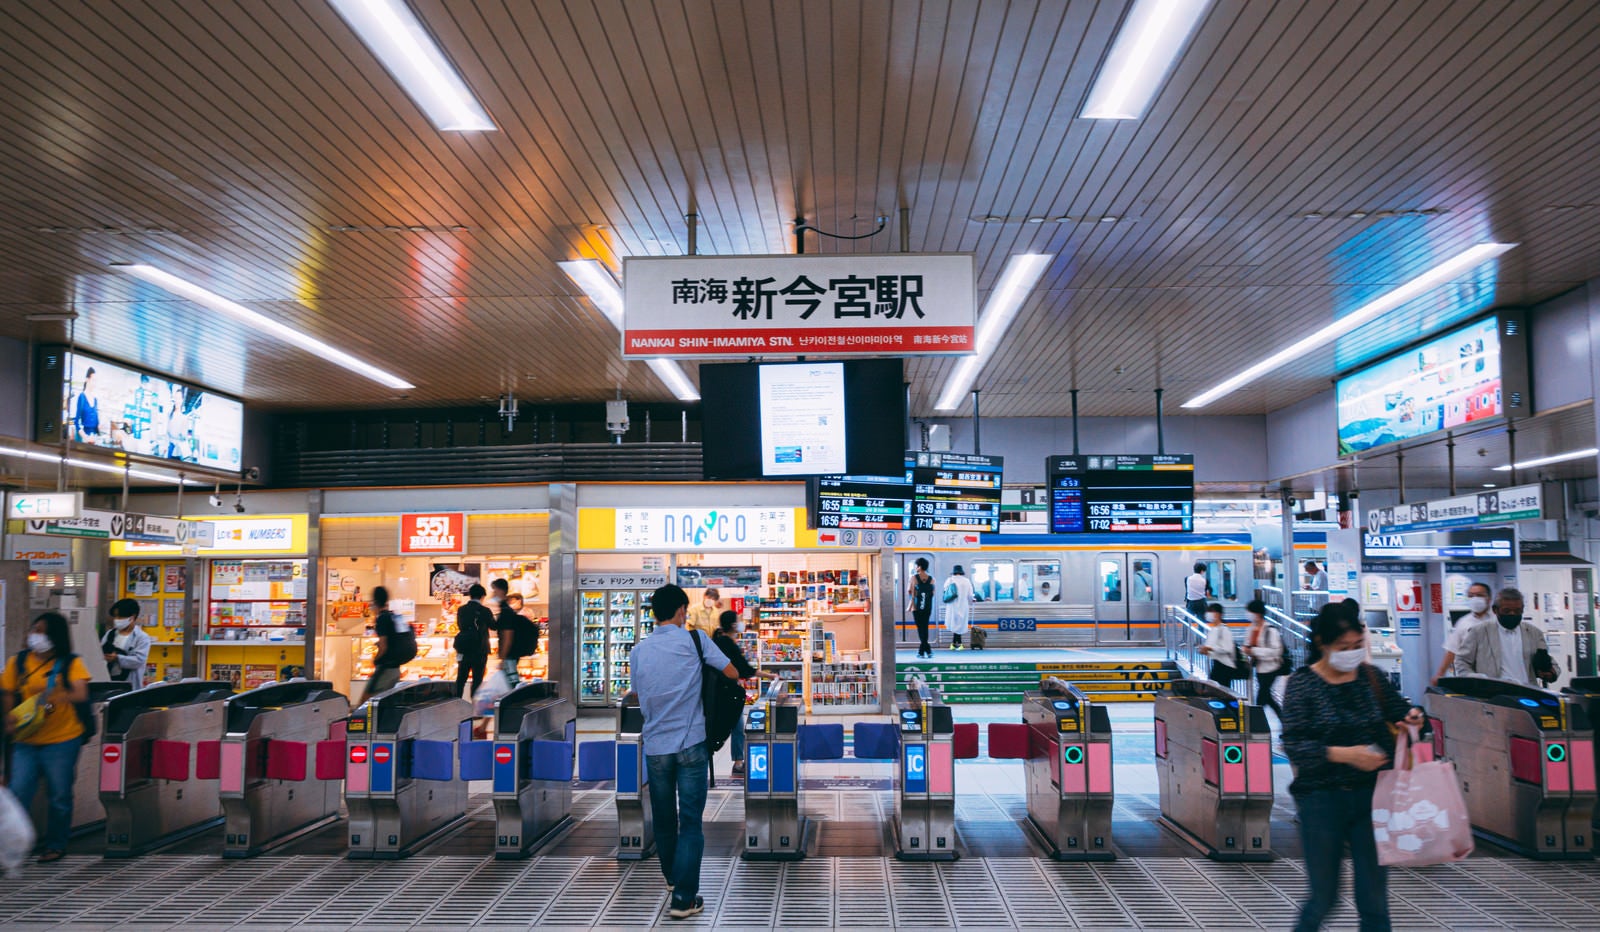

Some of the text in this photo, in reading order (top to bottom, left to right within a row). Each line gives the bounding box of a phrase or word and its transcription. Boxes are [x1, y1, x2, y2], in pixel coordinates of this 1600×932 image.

[631, 336, 794, 348] NANKAI SHIN-IMAMIYA STN.
[906, 473, 913, 482] 2
[994, 476, 1000, 485] 3
[1024, 492, 1030, 502] 1
[822, 500, 840, 511] 16:55
[904, 503, 911, 513] 2
[1489, 495, 1497, 511] 2
[917, 504, 933, 514] 16:59
[992, 506, 998, 515] 3
[1090, 505, 1110, 515] 16:56
[1183, 505, 1189, 514] 1
[126, 517, 133, 530] 3
[136, 518, 143, 531] 4
[416, 516, 449, 536] 551
[821, 515, 839, 526] 16:56
[903, 518, 909, 527] 4
[916, 518, 933, 529] 17:10
[992, 522, 998, 530] 3
[1090, 519, 1110, 530] 17:02
[1184, 519, 1189, 528] 1
[760, 537, 786, 545] ビール
[906, 533, 958, 546] のりば
[1371, 535, 1403, 546] ATM
[15, 551, 68, 560] コインロッカー
[580, 577, 605, 585] ビール
[610, 577, 635, 585] ドリンク
[1000, 619, 1034, 630] 6852
[751, 754, 766, 772] IC
[908, 754, 923, 772] IC
